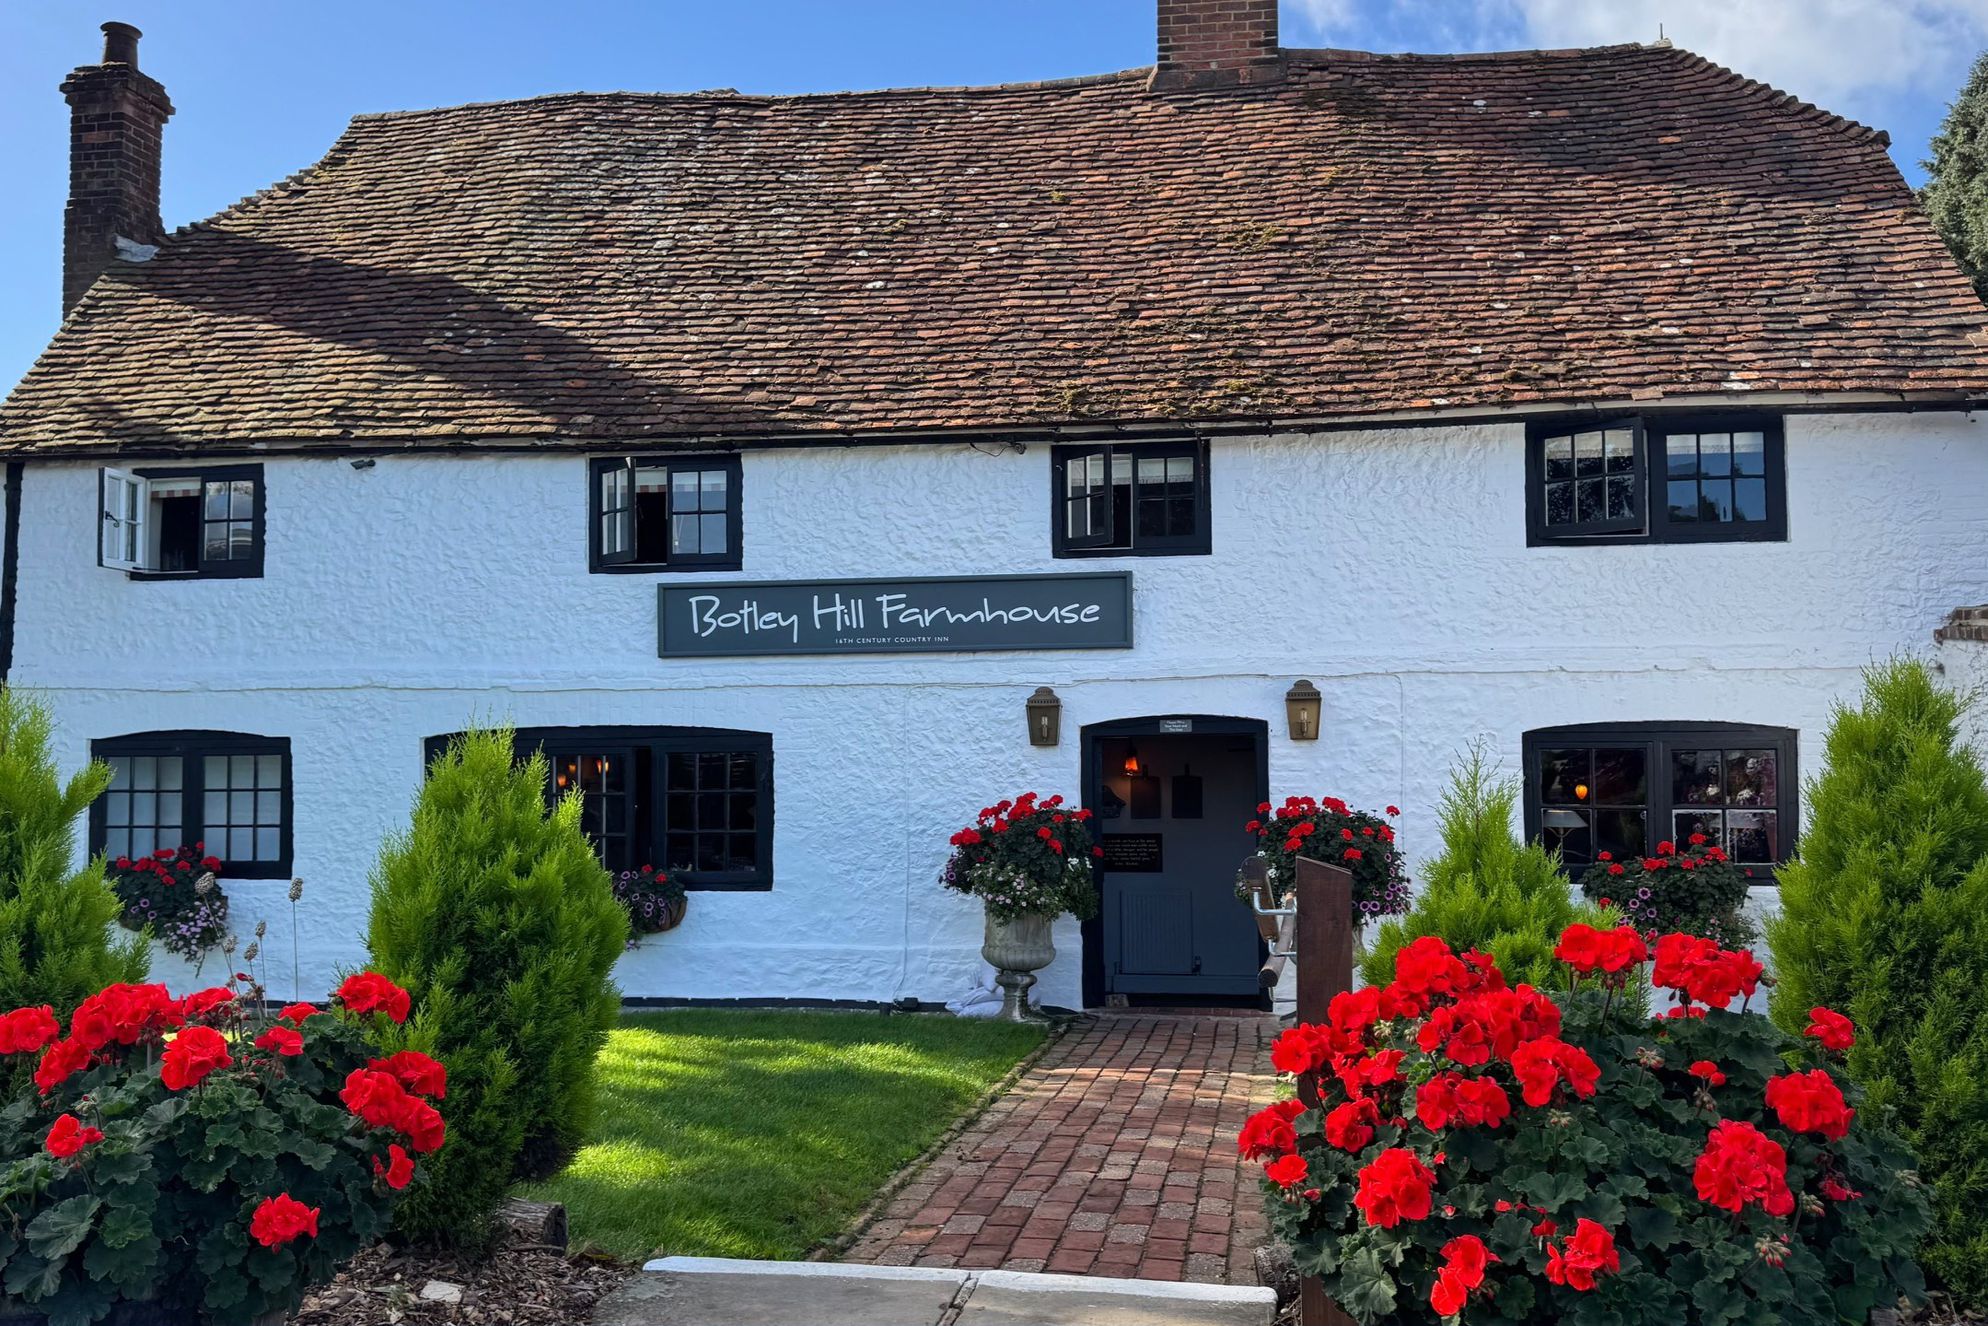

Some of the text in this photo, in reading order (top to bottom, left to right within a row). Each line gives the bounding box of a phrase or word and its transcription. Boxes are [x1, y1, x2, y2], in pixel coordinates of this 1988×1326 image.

[688, 593, 1101, 644] Botley Hill Farmhouse
